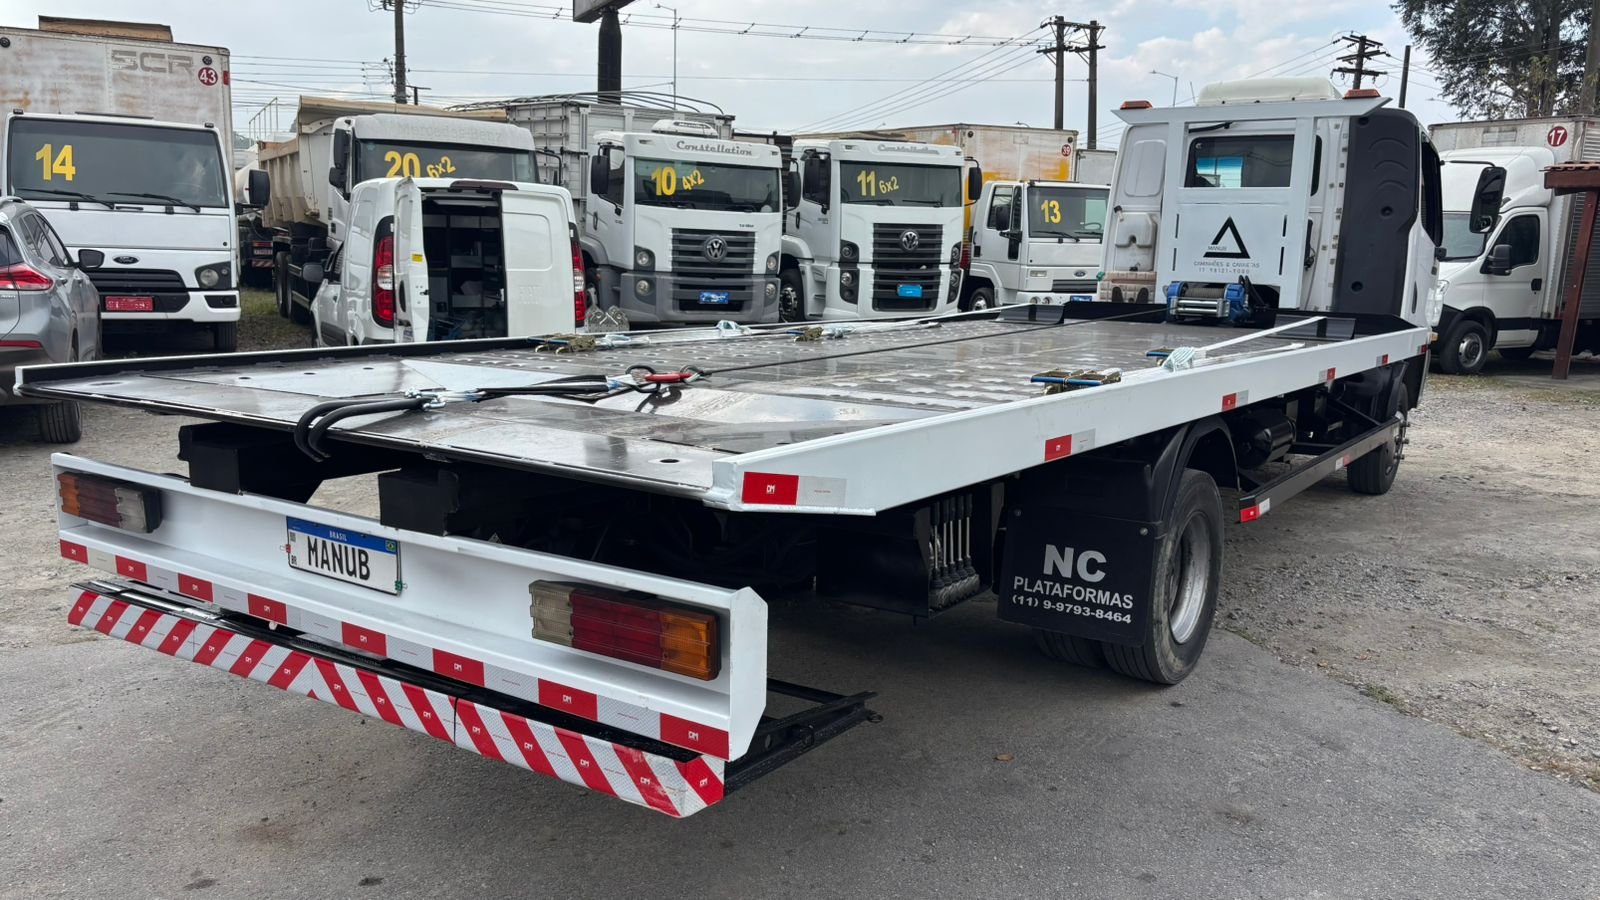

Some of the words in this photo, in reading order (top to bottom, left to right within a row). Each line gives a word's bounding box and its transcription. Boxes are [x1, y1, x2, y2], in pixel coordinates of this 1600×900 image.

[111, 50, 193, 74] SCR
[199, 70, 217, 84] 43
[1548, 129, 1565, 145] 17
[676, 140, 752, 156] Constellation
[35, 143, 76, 181] 14
[384, 151, 420, 178] 20
[652, 166, 677, 196] 10
[682, 169, 705, 191] 4x2
[857, 170, 876, 197] 11
[879, 176, 899, 194] 6x2
[1041, 200, 1062, 224] 13
[767, 485, 775, 493] DM
[329, 530, 348, 541] BRASIL
[307, 535, 370, 580] MANUB
[1043, 544, 1107, 582] NC
[1013, 576, 1134, 609] PLATAFORMAS
[1012, 594, 1039, 608] (11)
[1043, 600, 1132, 624] 9-9793-8464
[454, 663, 462, 671] DM
[563, 695, 571, 704] DM
[473, 726, 481, 734] DM
[689, 731, 699, 741] DM
[524, 742, 533, 750] DM
[580, 759, 590, 767] DM
